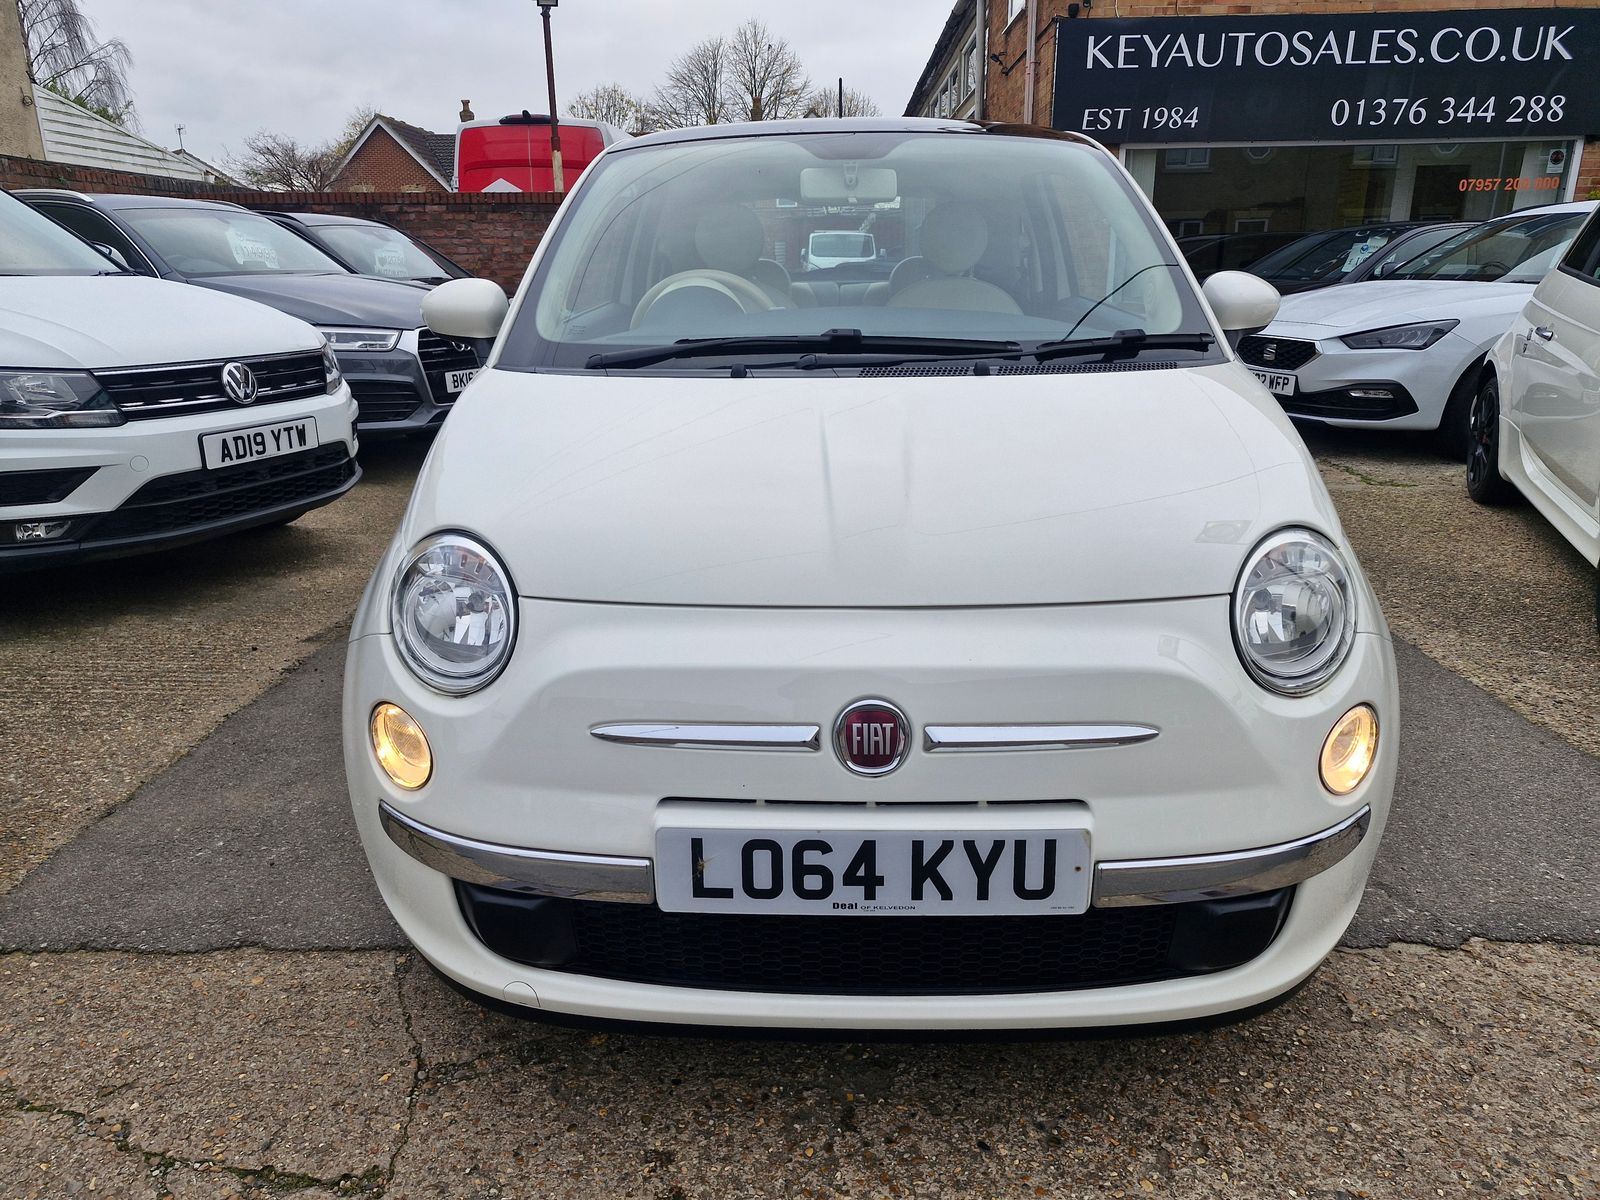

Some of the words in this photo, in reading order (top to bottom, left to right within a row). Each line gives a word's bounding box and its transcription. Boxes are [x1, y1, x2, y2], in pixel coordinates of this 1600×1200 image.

[1086, 25, 1575, 69] KEYAUTOSALES.CO.UK
[1081, 108, 1131, 130] EST
[1142, 106, 1199, 130] 1984
[1330, 97, 1428, 126] 01376
[1437, 96, 1496, 125] 344
[1505, 95, 1566, 123] 288
[1458, 178, 1501, 192] 07957
[1268, 375, 1290, 391] WFP
[221, 432, 266, 463] AD19
[271, 424, 306, 452] YTW
[852, 722, 894, 755] FIAT
[691, 838, 884, 900] LO64
[911, 839, 1057, 900] KYU
[832, 902, 858, 910] Deal
